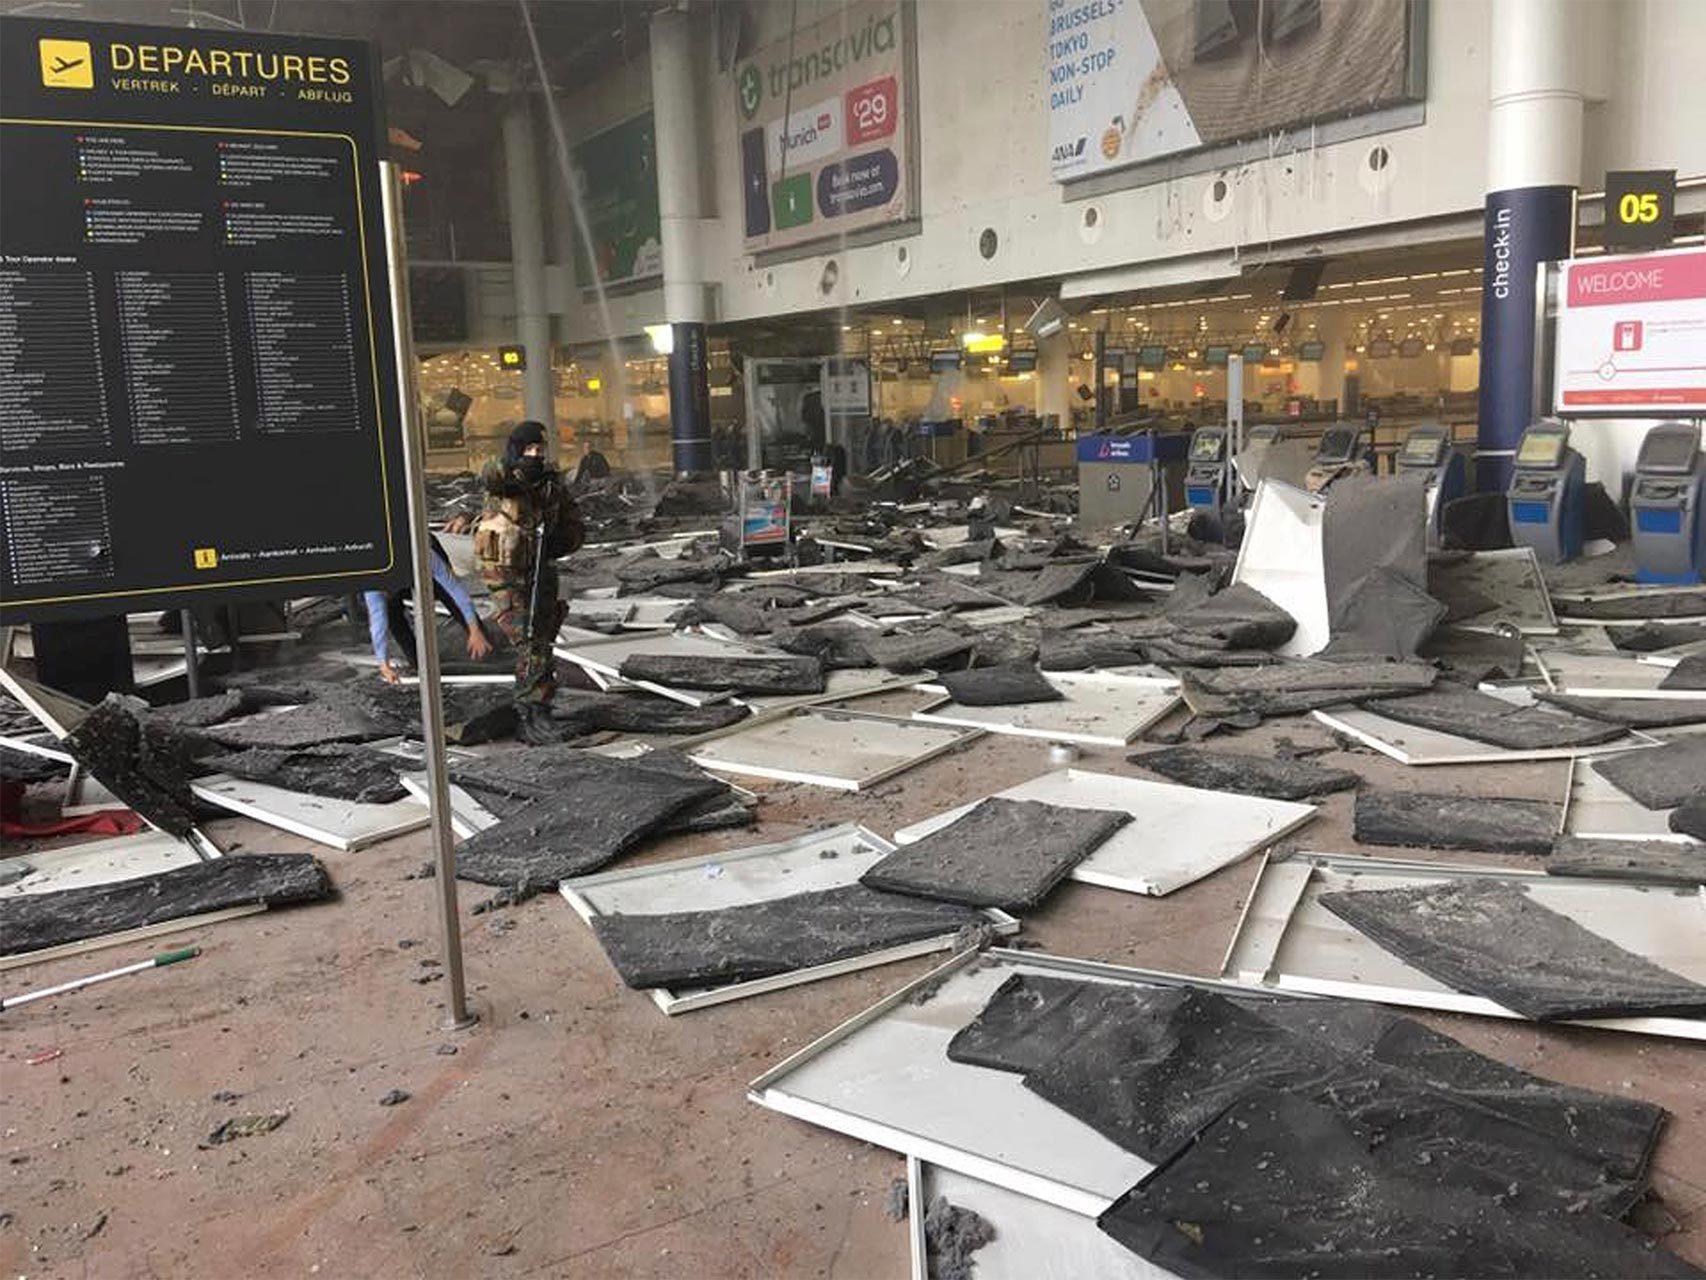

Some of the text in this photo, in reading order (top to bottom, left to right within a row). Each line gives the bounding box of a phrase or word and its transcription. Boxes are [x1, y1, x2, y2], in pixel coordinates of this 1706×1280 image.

[769, 13, 897, 98] transavia
[1050, 32, 1088, 60] TOKYO
[110, 43, 351, 84] DEPARTURES
[1050, 48, 1116, 86] NON-STOP
[112, 78, 180, 92] VERTREK
[212, 82, 267, 97] DÉPART
[298, 88, 353, 103] ABFLUG
[1050, 85, 1083, 110] DAILY
[1619, 194, 1659, 223] 05
[1492, 208, 1511, 299] check-in
[1577, 269, 1663, 294] WELCOME
